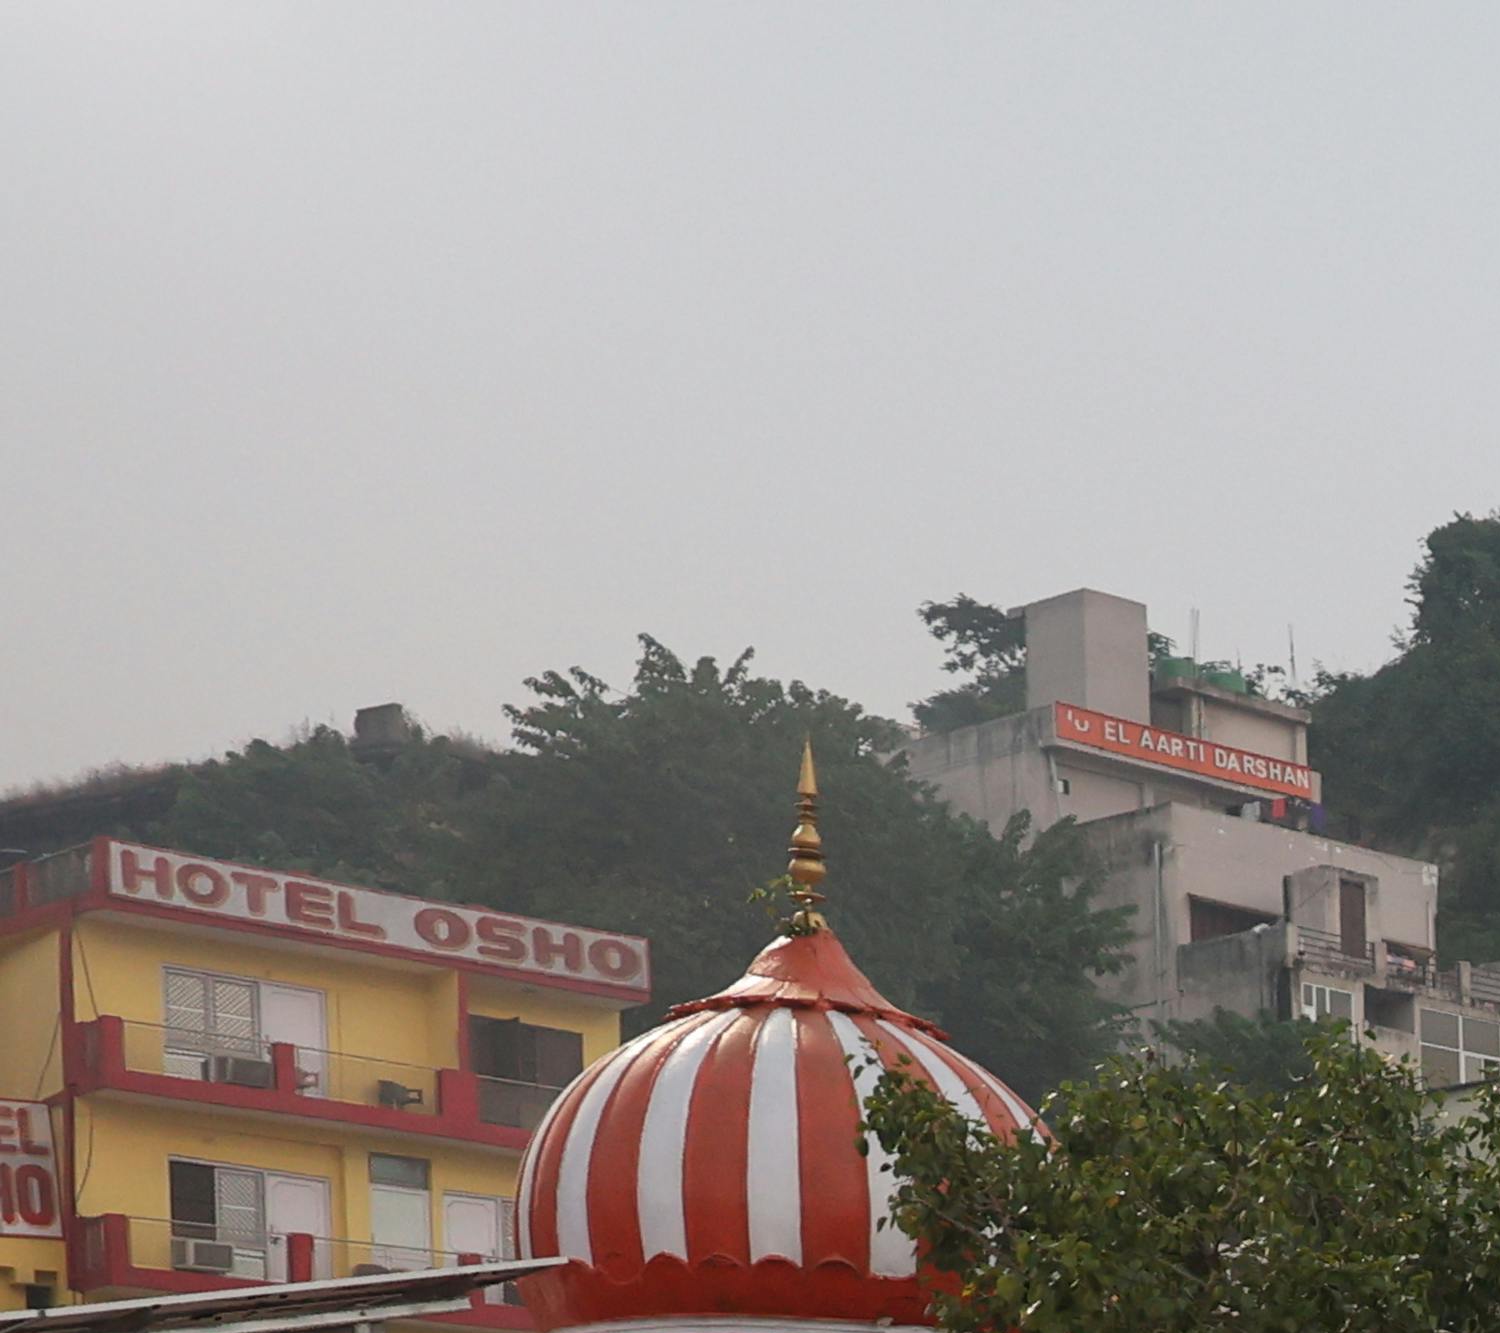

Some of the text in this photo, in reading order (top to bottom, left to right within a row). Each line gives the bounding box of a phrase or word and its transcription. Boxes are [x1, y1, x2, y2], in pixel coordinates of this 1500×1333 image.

[1140, 729, 1310, 789] AARTI DARSHAN
[119, 848, 642, 981] HOTEL OSHO
